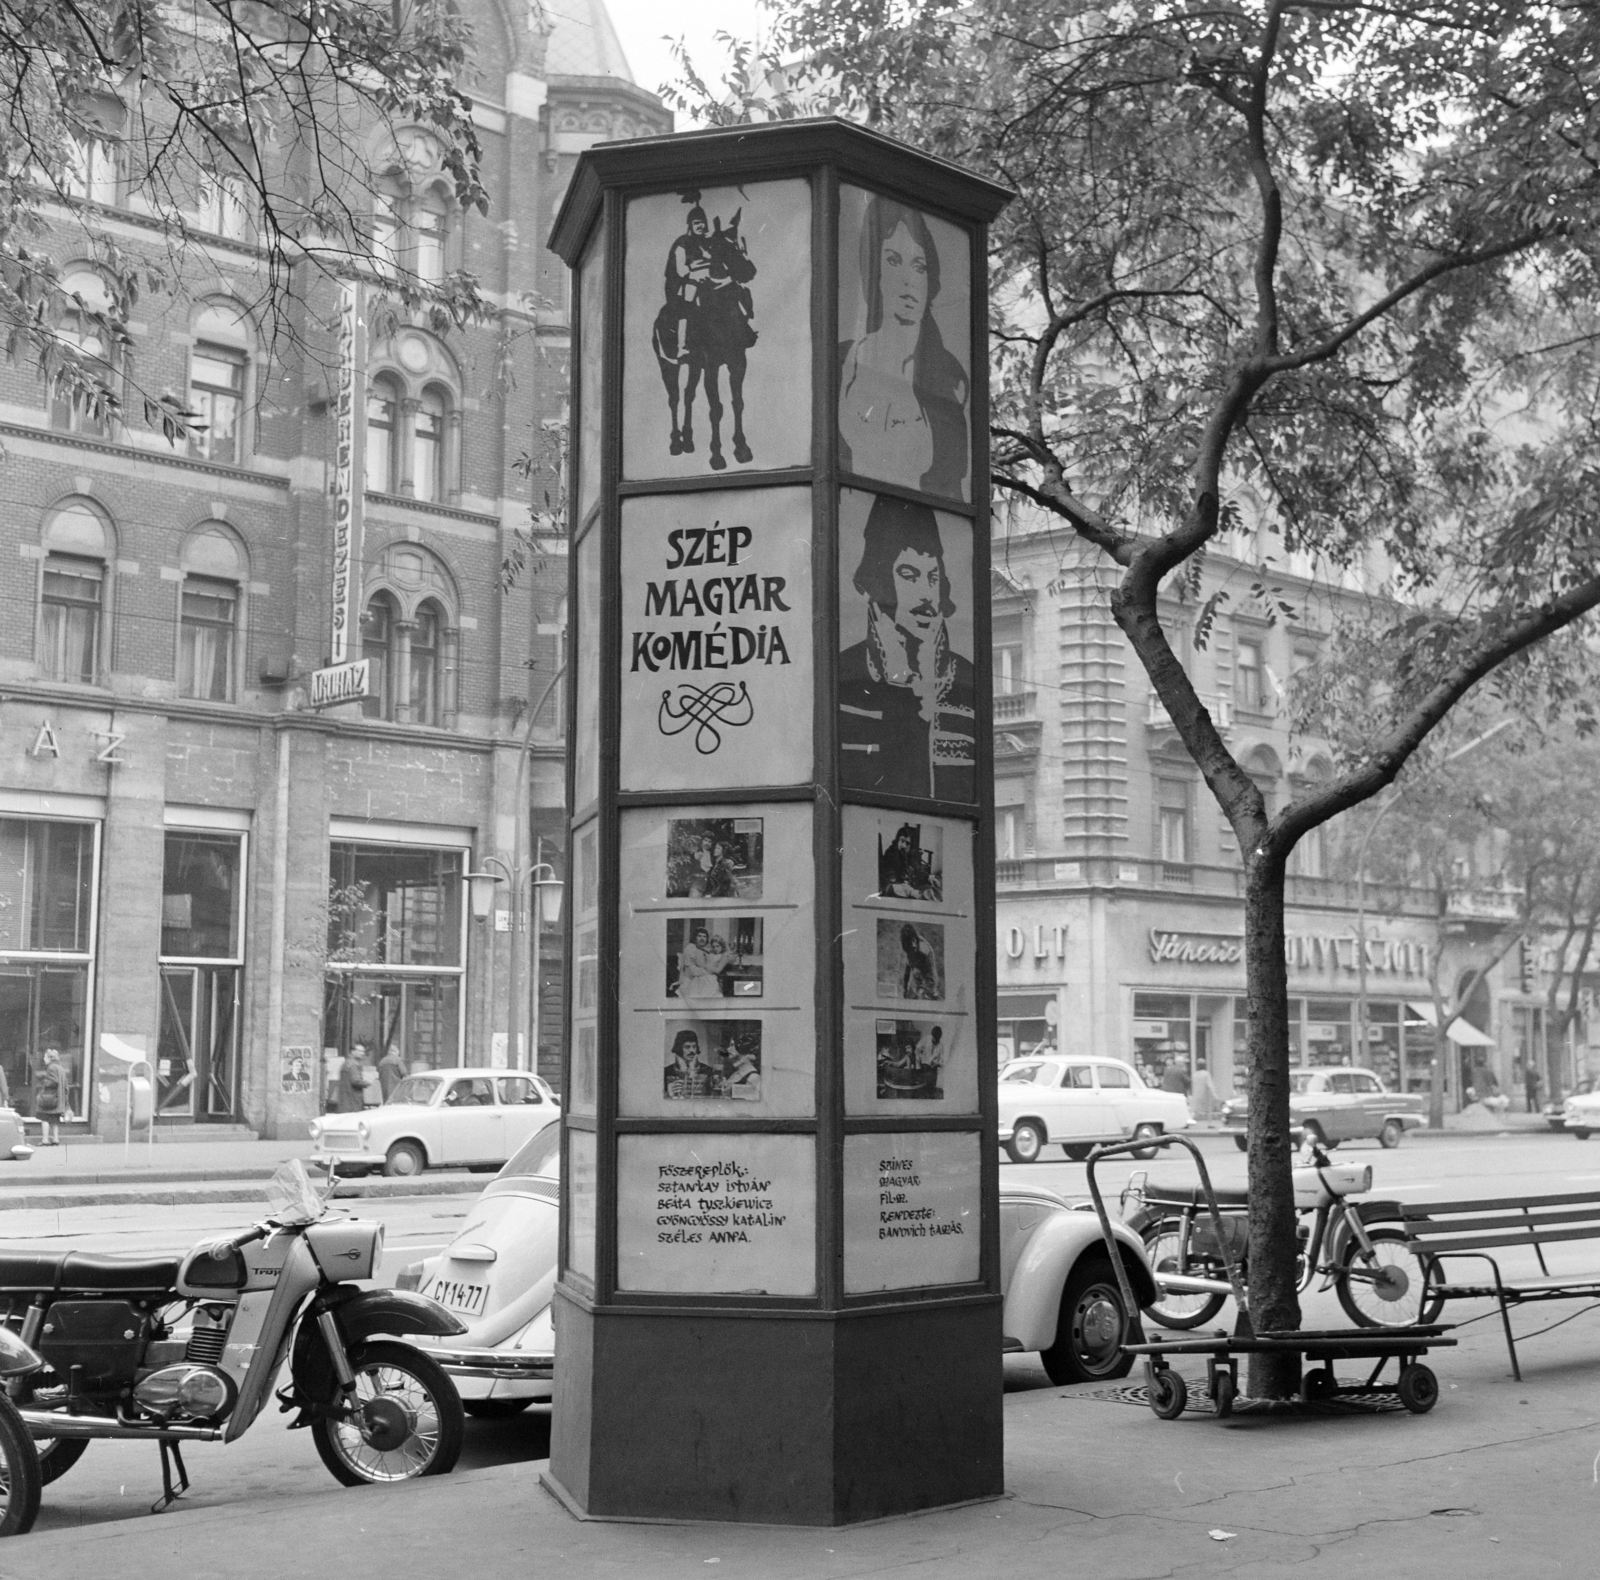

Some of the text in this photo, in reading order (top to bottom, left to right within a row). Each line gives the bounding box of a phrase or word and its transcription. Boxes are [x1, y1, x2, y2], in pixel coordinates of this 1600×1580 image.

[666, 520, 752, 570] SZÉP
[645, 573, 791, 617] MAGYAR
[1149, 927, 1246, 962] Táncsic
